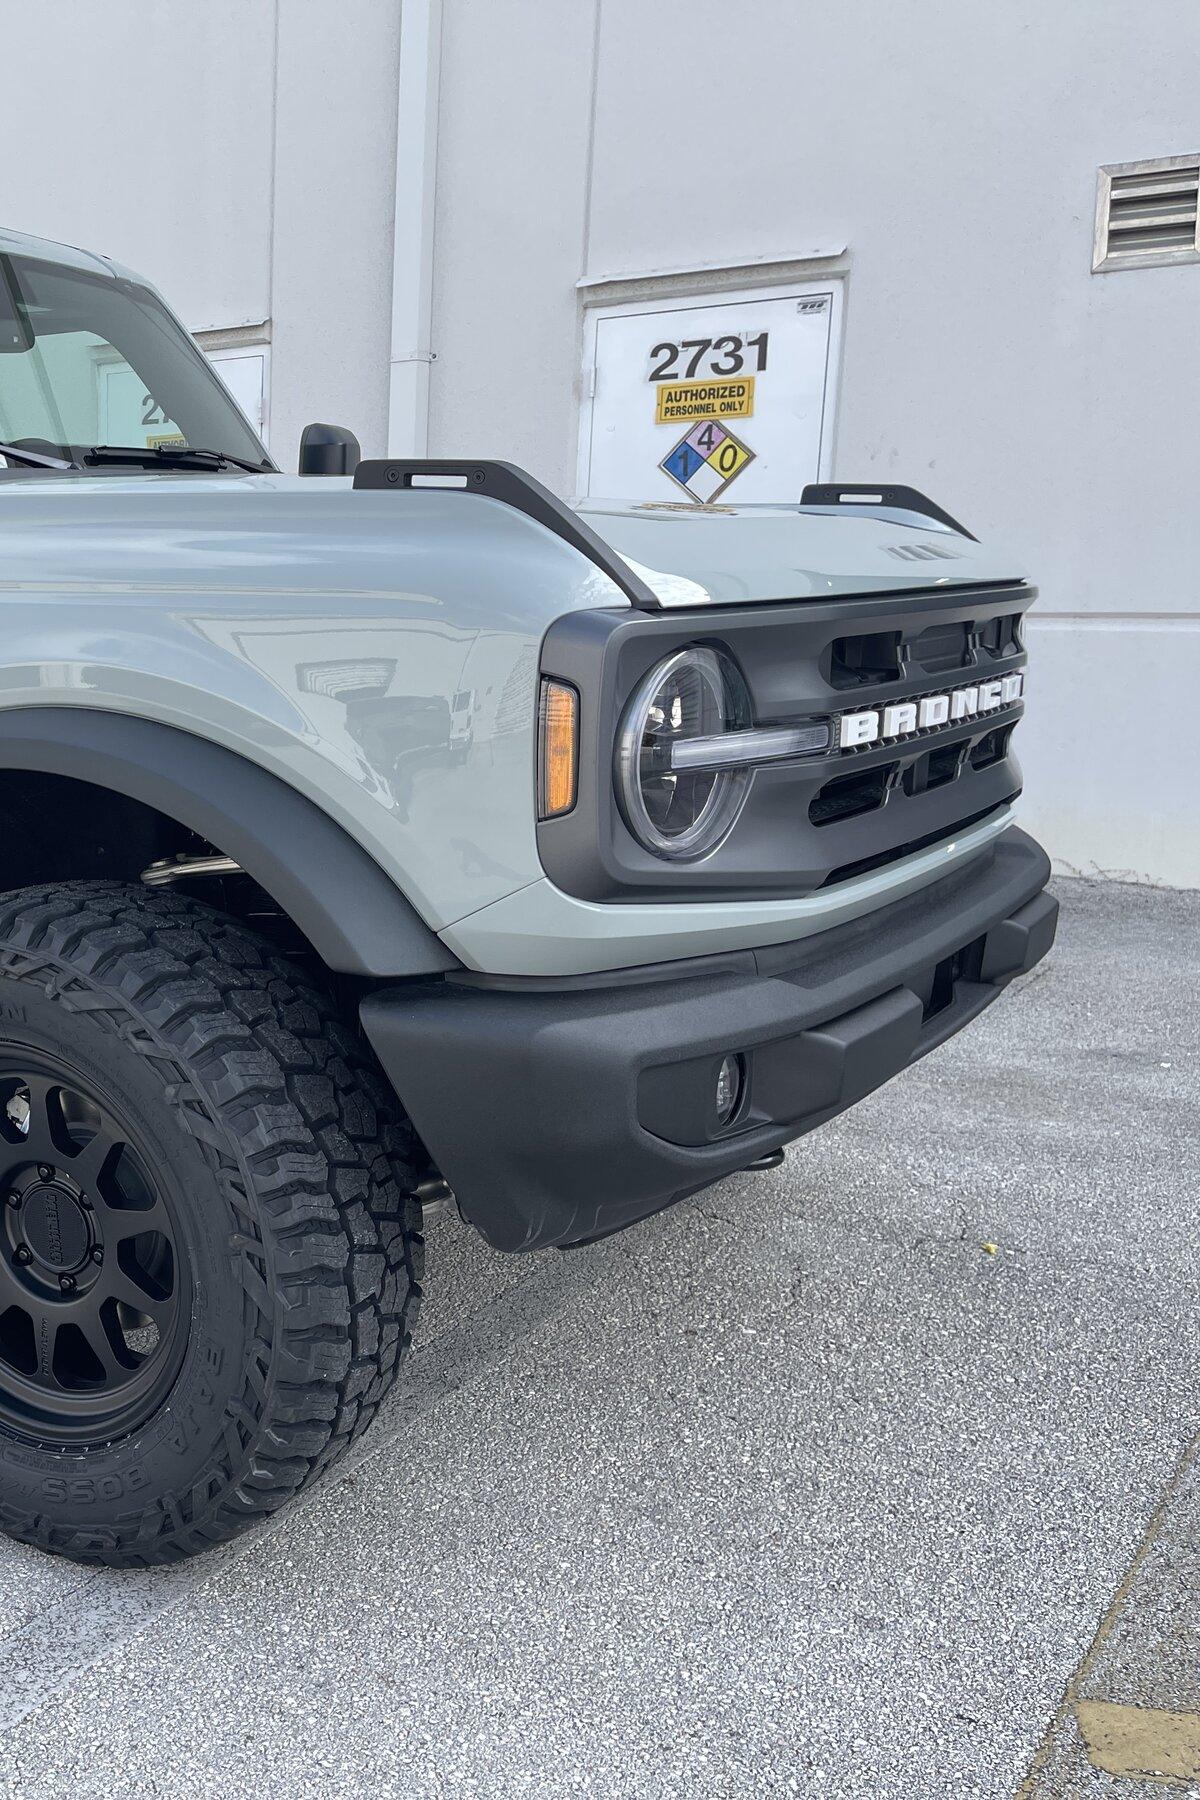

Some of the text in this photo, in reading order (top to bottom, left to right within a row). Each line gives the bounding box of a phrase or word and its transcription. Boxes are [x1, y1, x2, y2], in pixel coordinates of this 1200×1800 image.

[648, 332, 769, 382] 2731
[664, 400, 745, 417] PERSONNEL ONLY
[665, 385, 746, 404] AUTHORIZED
[697, 424, 715, 451] 4
[677, 450, 690, 477] 1
[719, 444, 738, 473] 0
[840, 673, 1024, 748] BRONCO
[41, 1463, 152, 1505] BOSS
